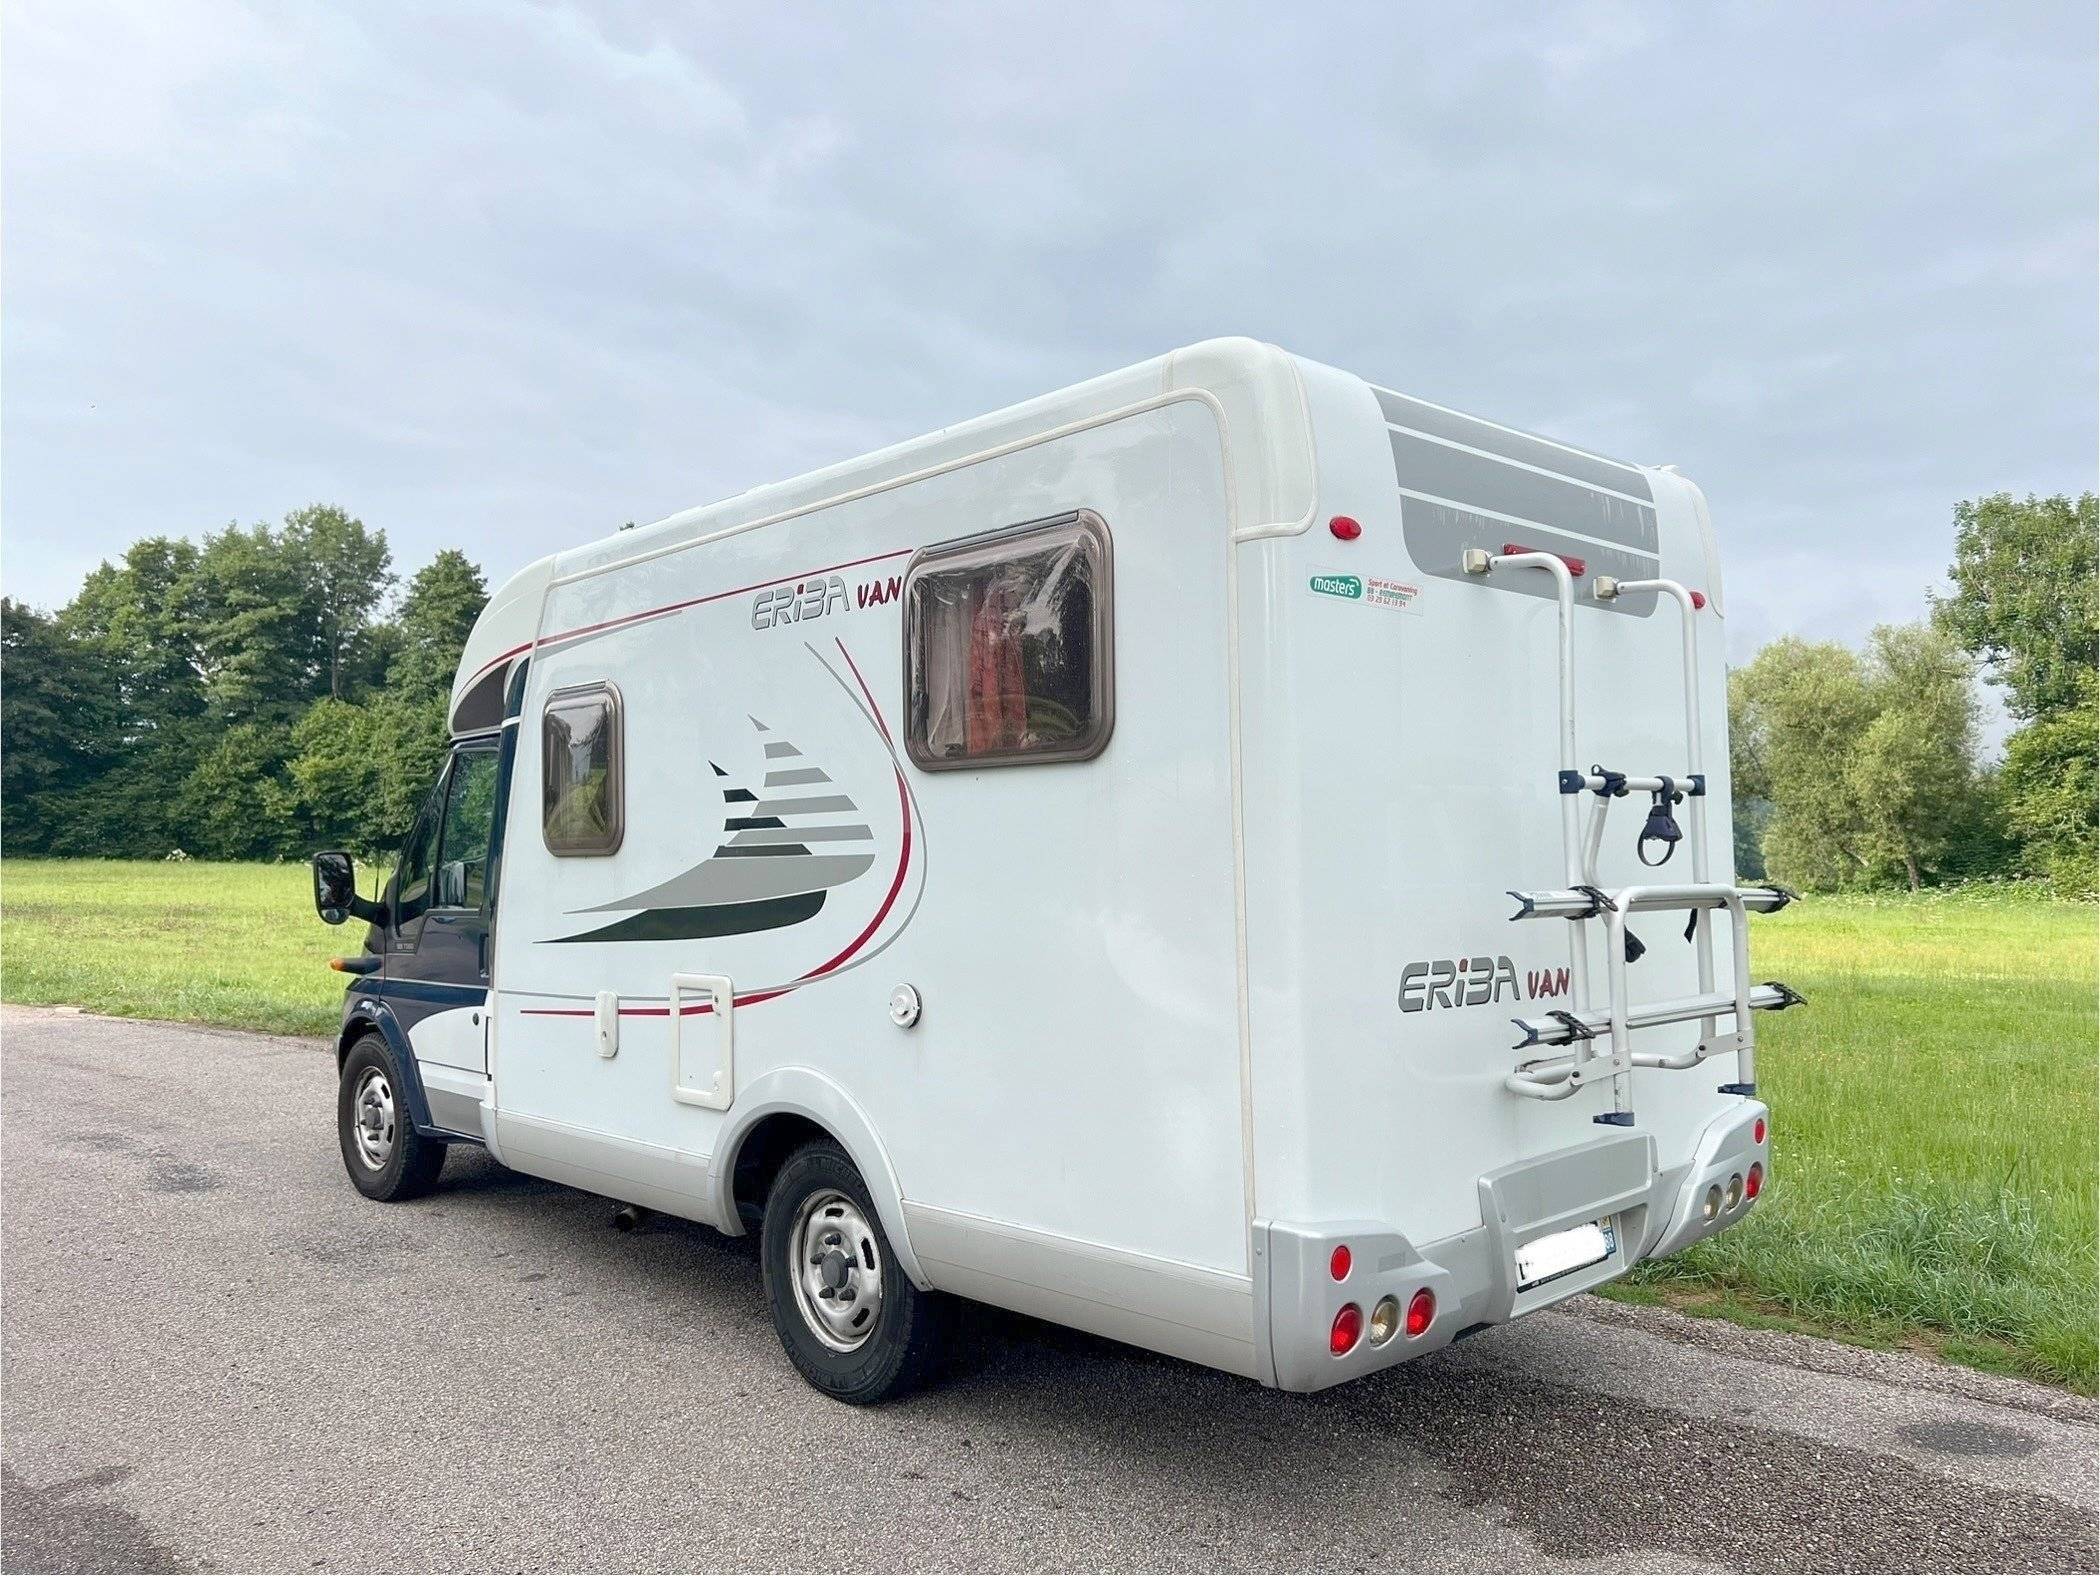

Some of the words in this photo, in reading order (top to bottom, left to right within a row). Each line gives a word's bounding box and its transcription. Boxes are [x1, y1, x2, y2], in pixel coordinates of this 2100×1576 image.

[857, 575, 902, 609] VAN
[1314, 577, 1355, 595] masters
[1368, 578, 1382, 588] Sport
[1527, 967, 1569, 1000] VAN
